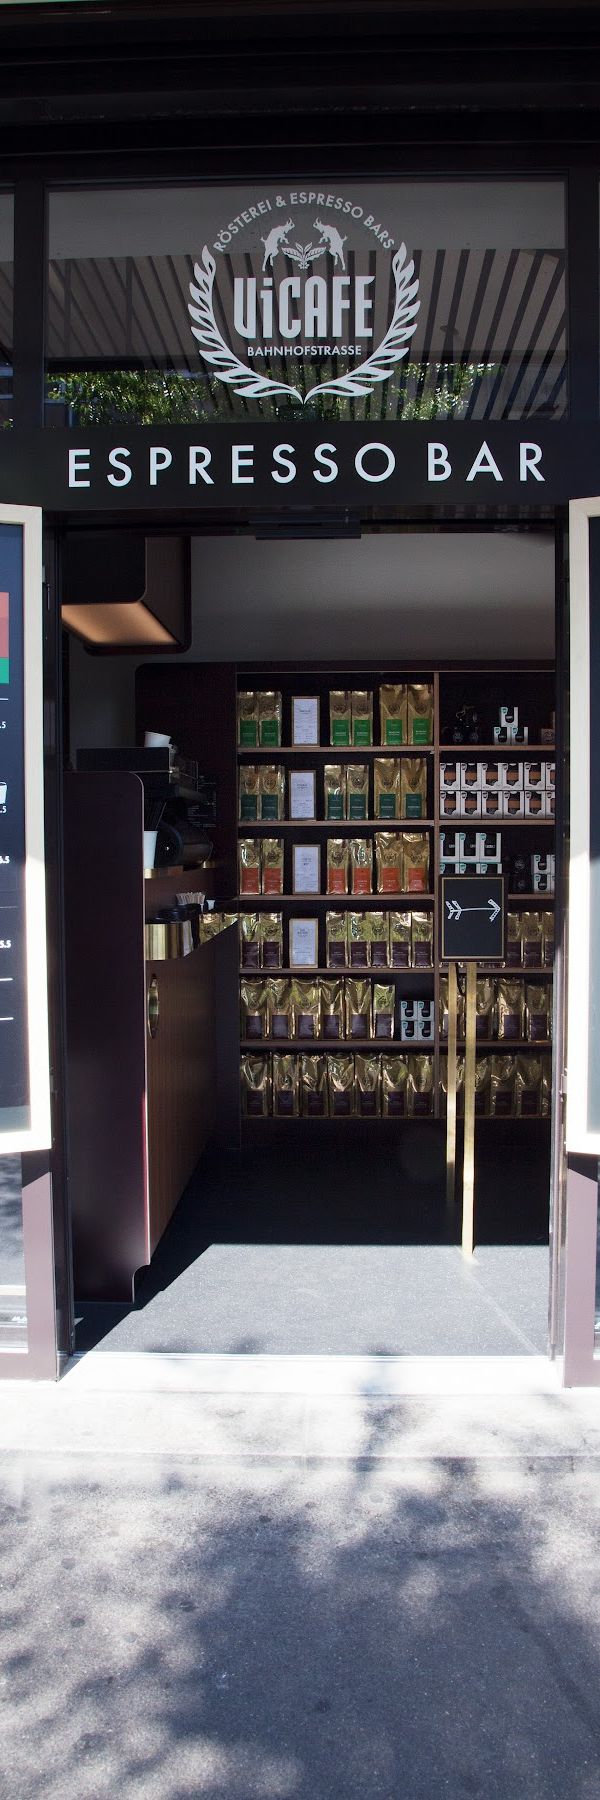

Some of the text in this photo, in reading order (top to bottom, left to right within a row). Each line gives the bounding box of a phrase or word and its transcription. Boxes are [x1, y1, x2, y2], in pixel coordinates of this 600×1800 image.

[213, 192, 395, 252] RÖSTEREI & ESPRESSO BARS
[247, 345, 362, 357] BAHNHOFSTRASSE
[68, 441, 546, 487] ESPRESSO BAR
